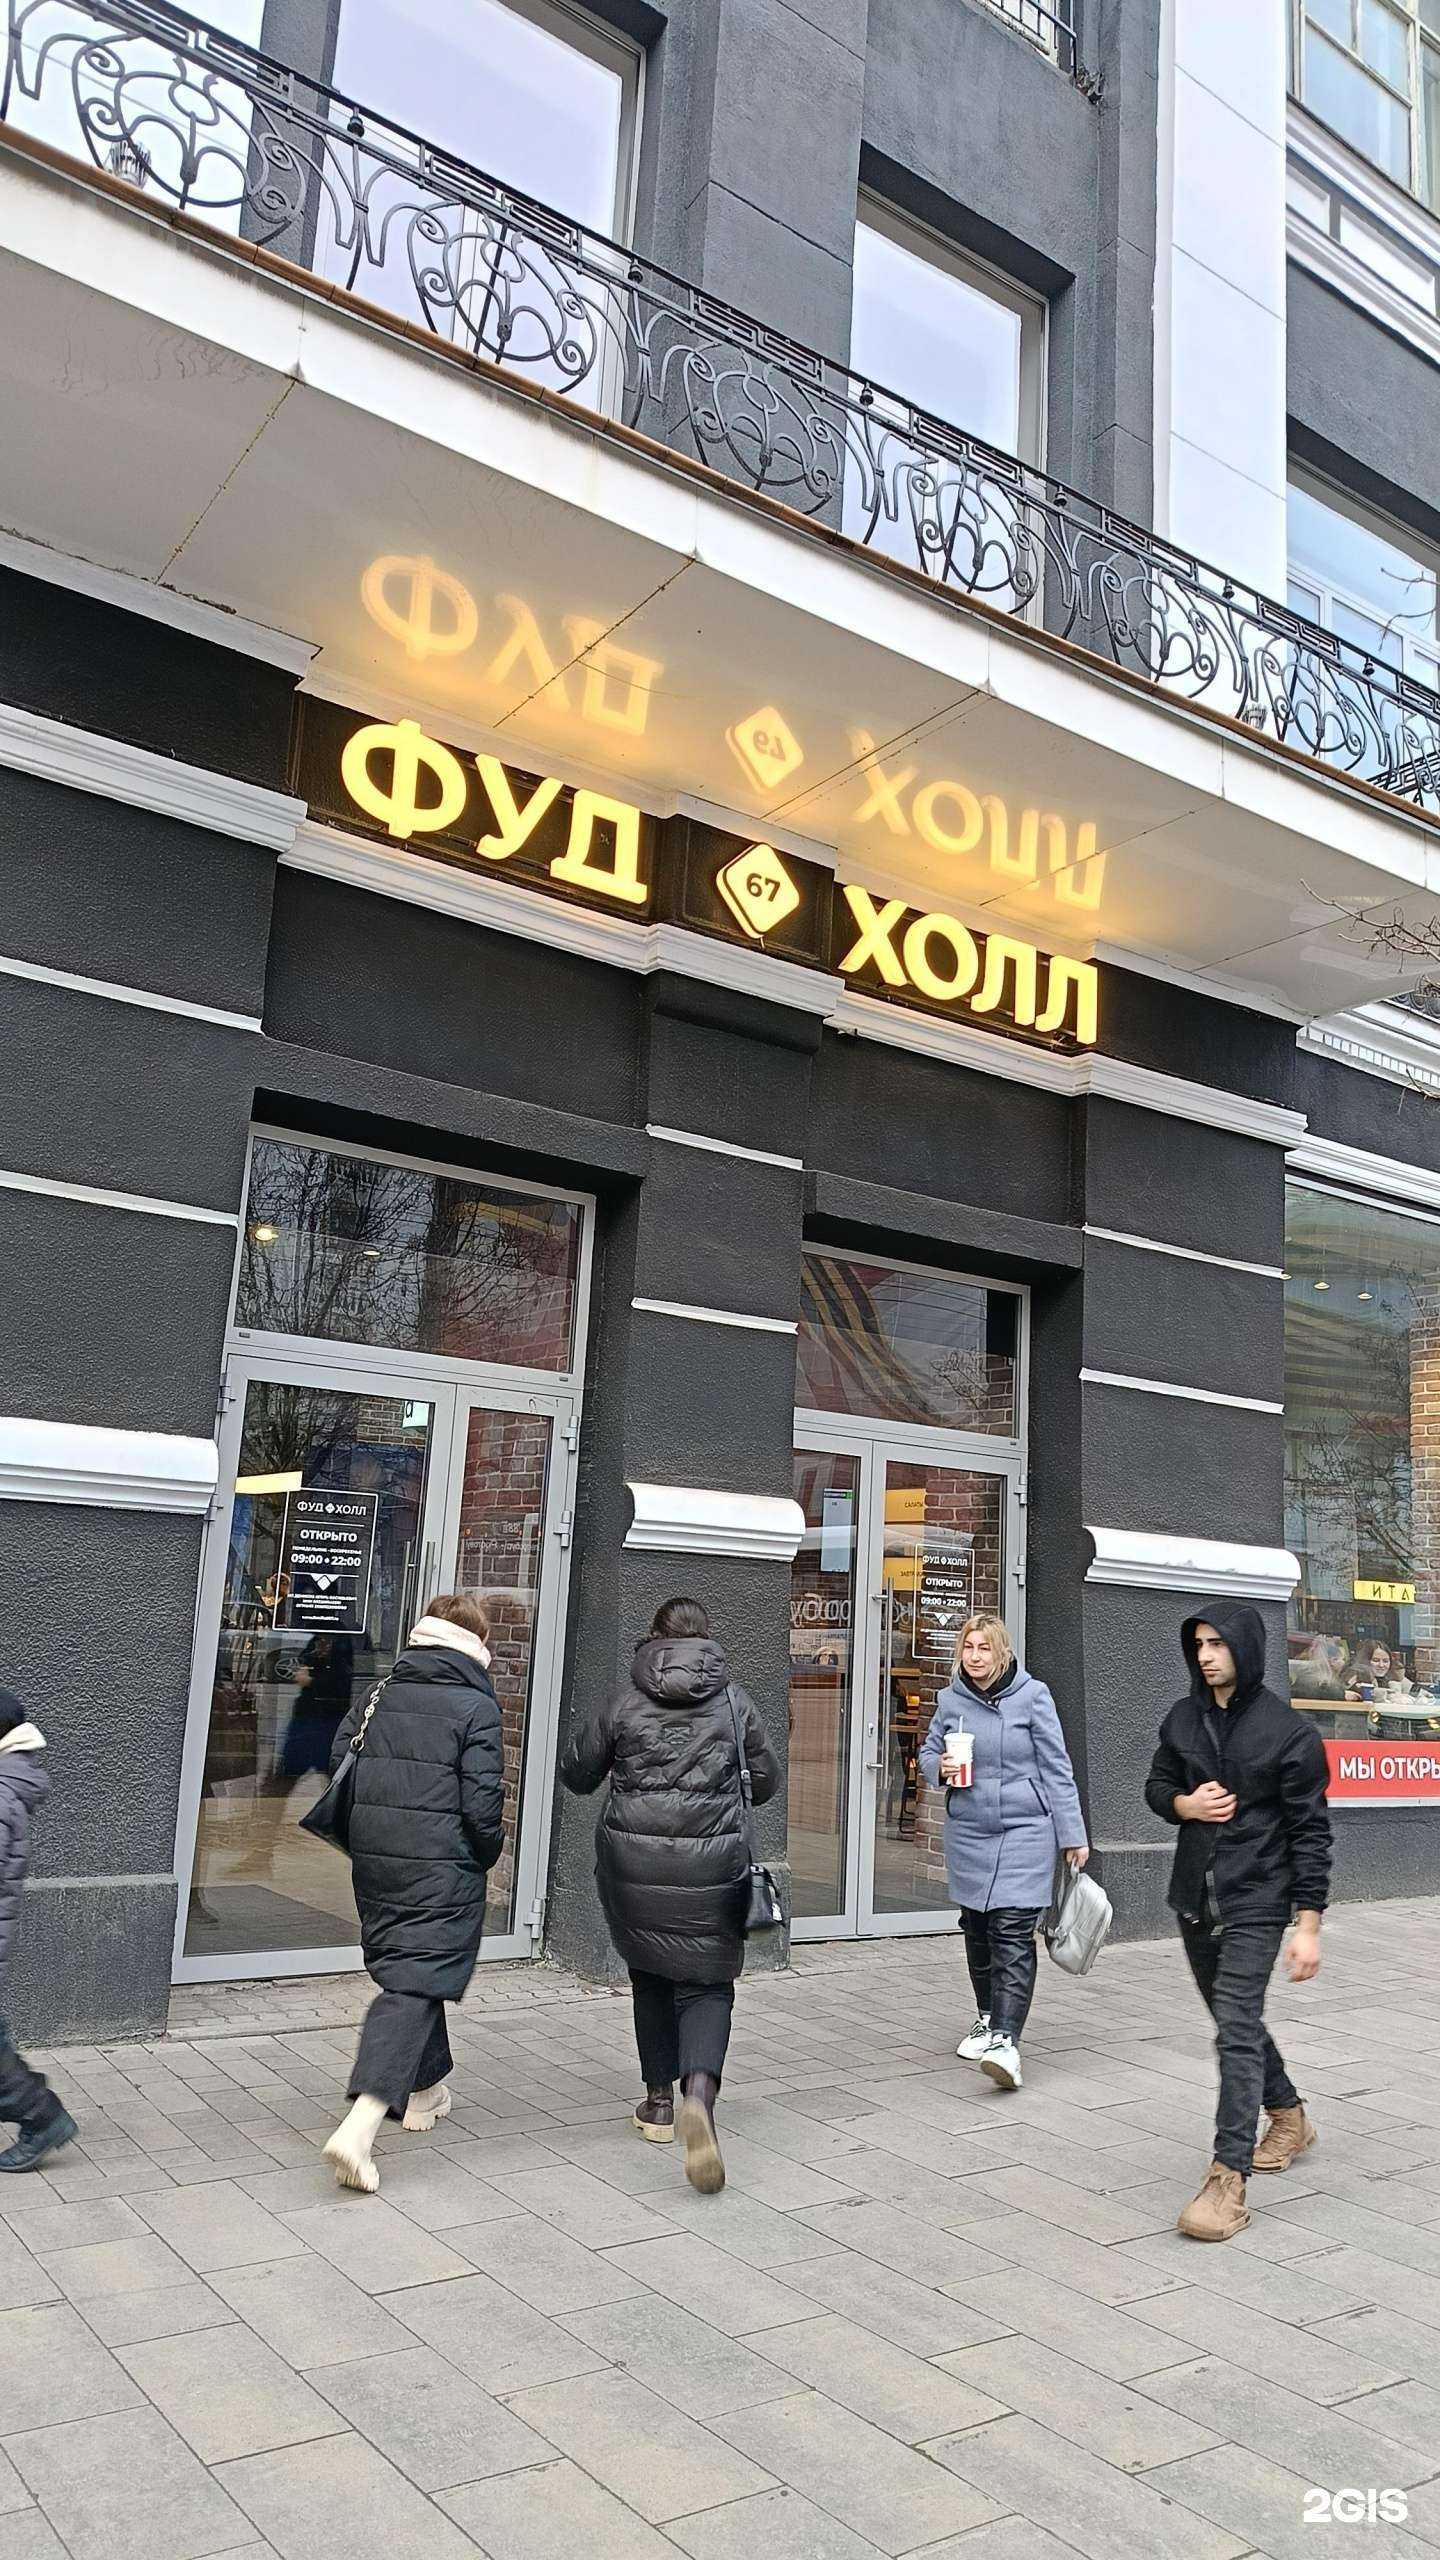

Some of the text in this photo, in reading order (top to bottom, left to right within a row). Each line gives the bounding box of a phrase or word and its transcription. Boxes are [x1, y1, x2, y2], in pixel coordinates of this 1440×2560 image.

[341, 719, 1099, 1044] ФУД 67 ХОЛЛ
[297, 1501, 367, 1516] ФУД ХОЛЛ
[300, 1529, 358, 1543] ОТКРЫТО
[290, 1553, 362, 1567] 09:00 22:00
[922, 1555, 968, 1566] ФУД ХОЛЛ
[925, 1577, 963, 1588] ОТКРЫТО
[920, 1596, 967, 1607] 09:00 22:00
[1340, 1756, 1375, 1780] МЫ
